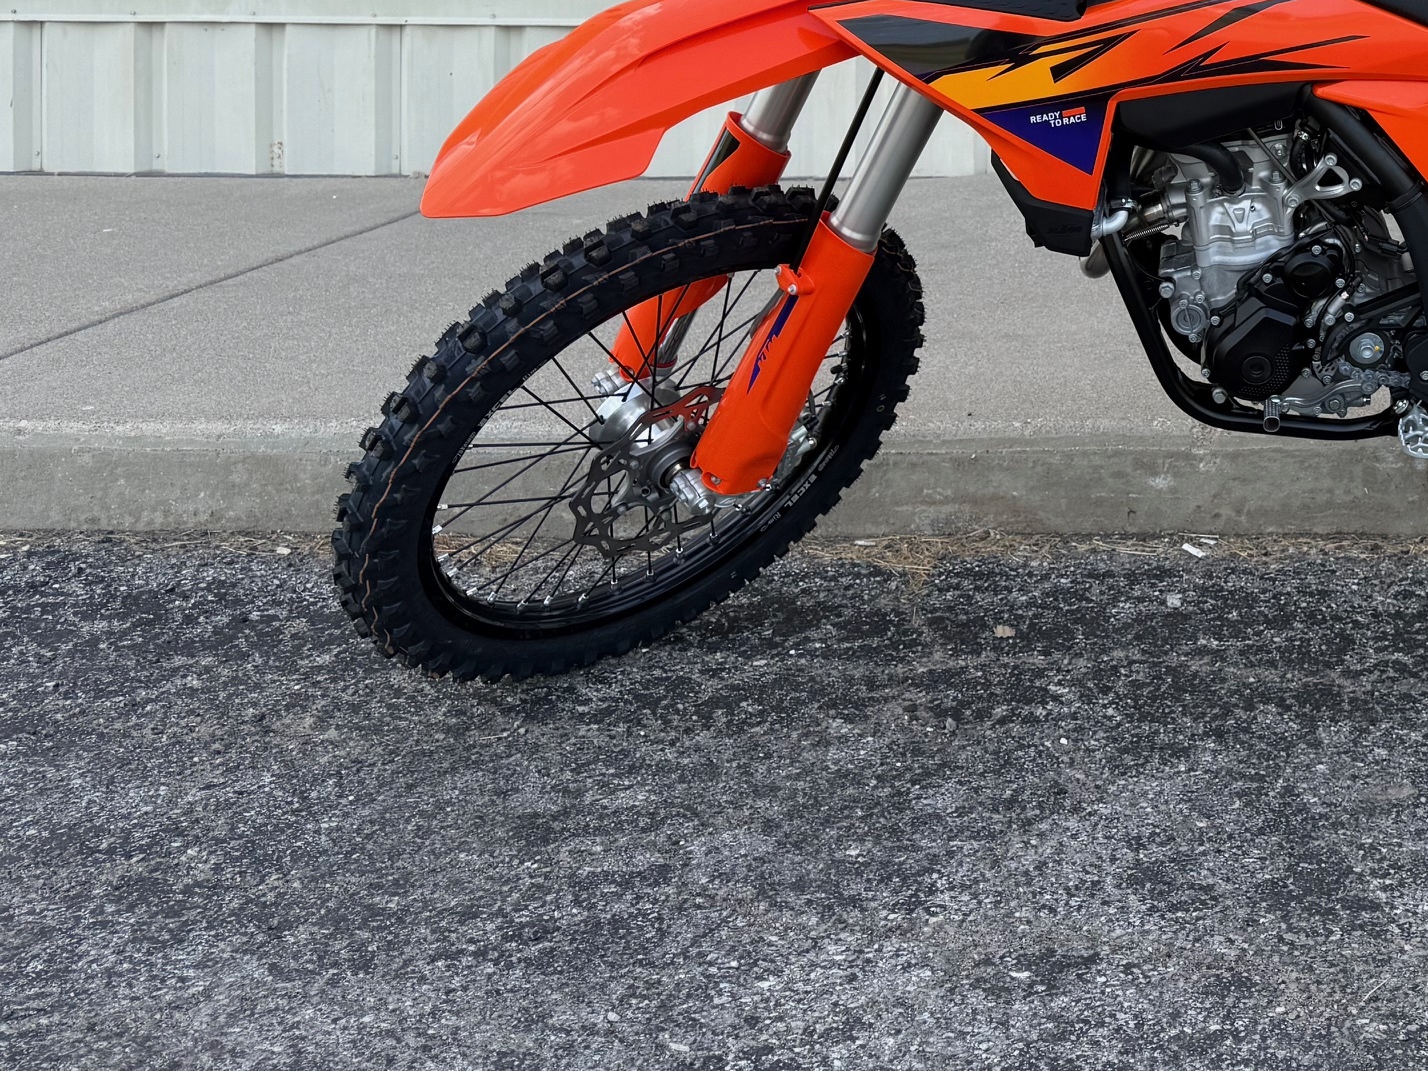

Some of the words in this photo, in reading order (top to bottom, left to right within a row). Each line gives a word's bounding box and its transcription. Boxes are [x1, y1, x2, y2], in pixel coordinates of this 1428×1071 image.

[1030, 111, 1060, 124] READY
[1049, 119, 1062, 127] TO
[1063, 113, 1087, 125] RACE
[784, 474, 818, 508] EXCEL
